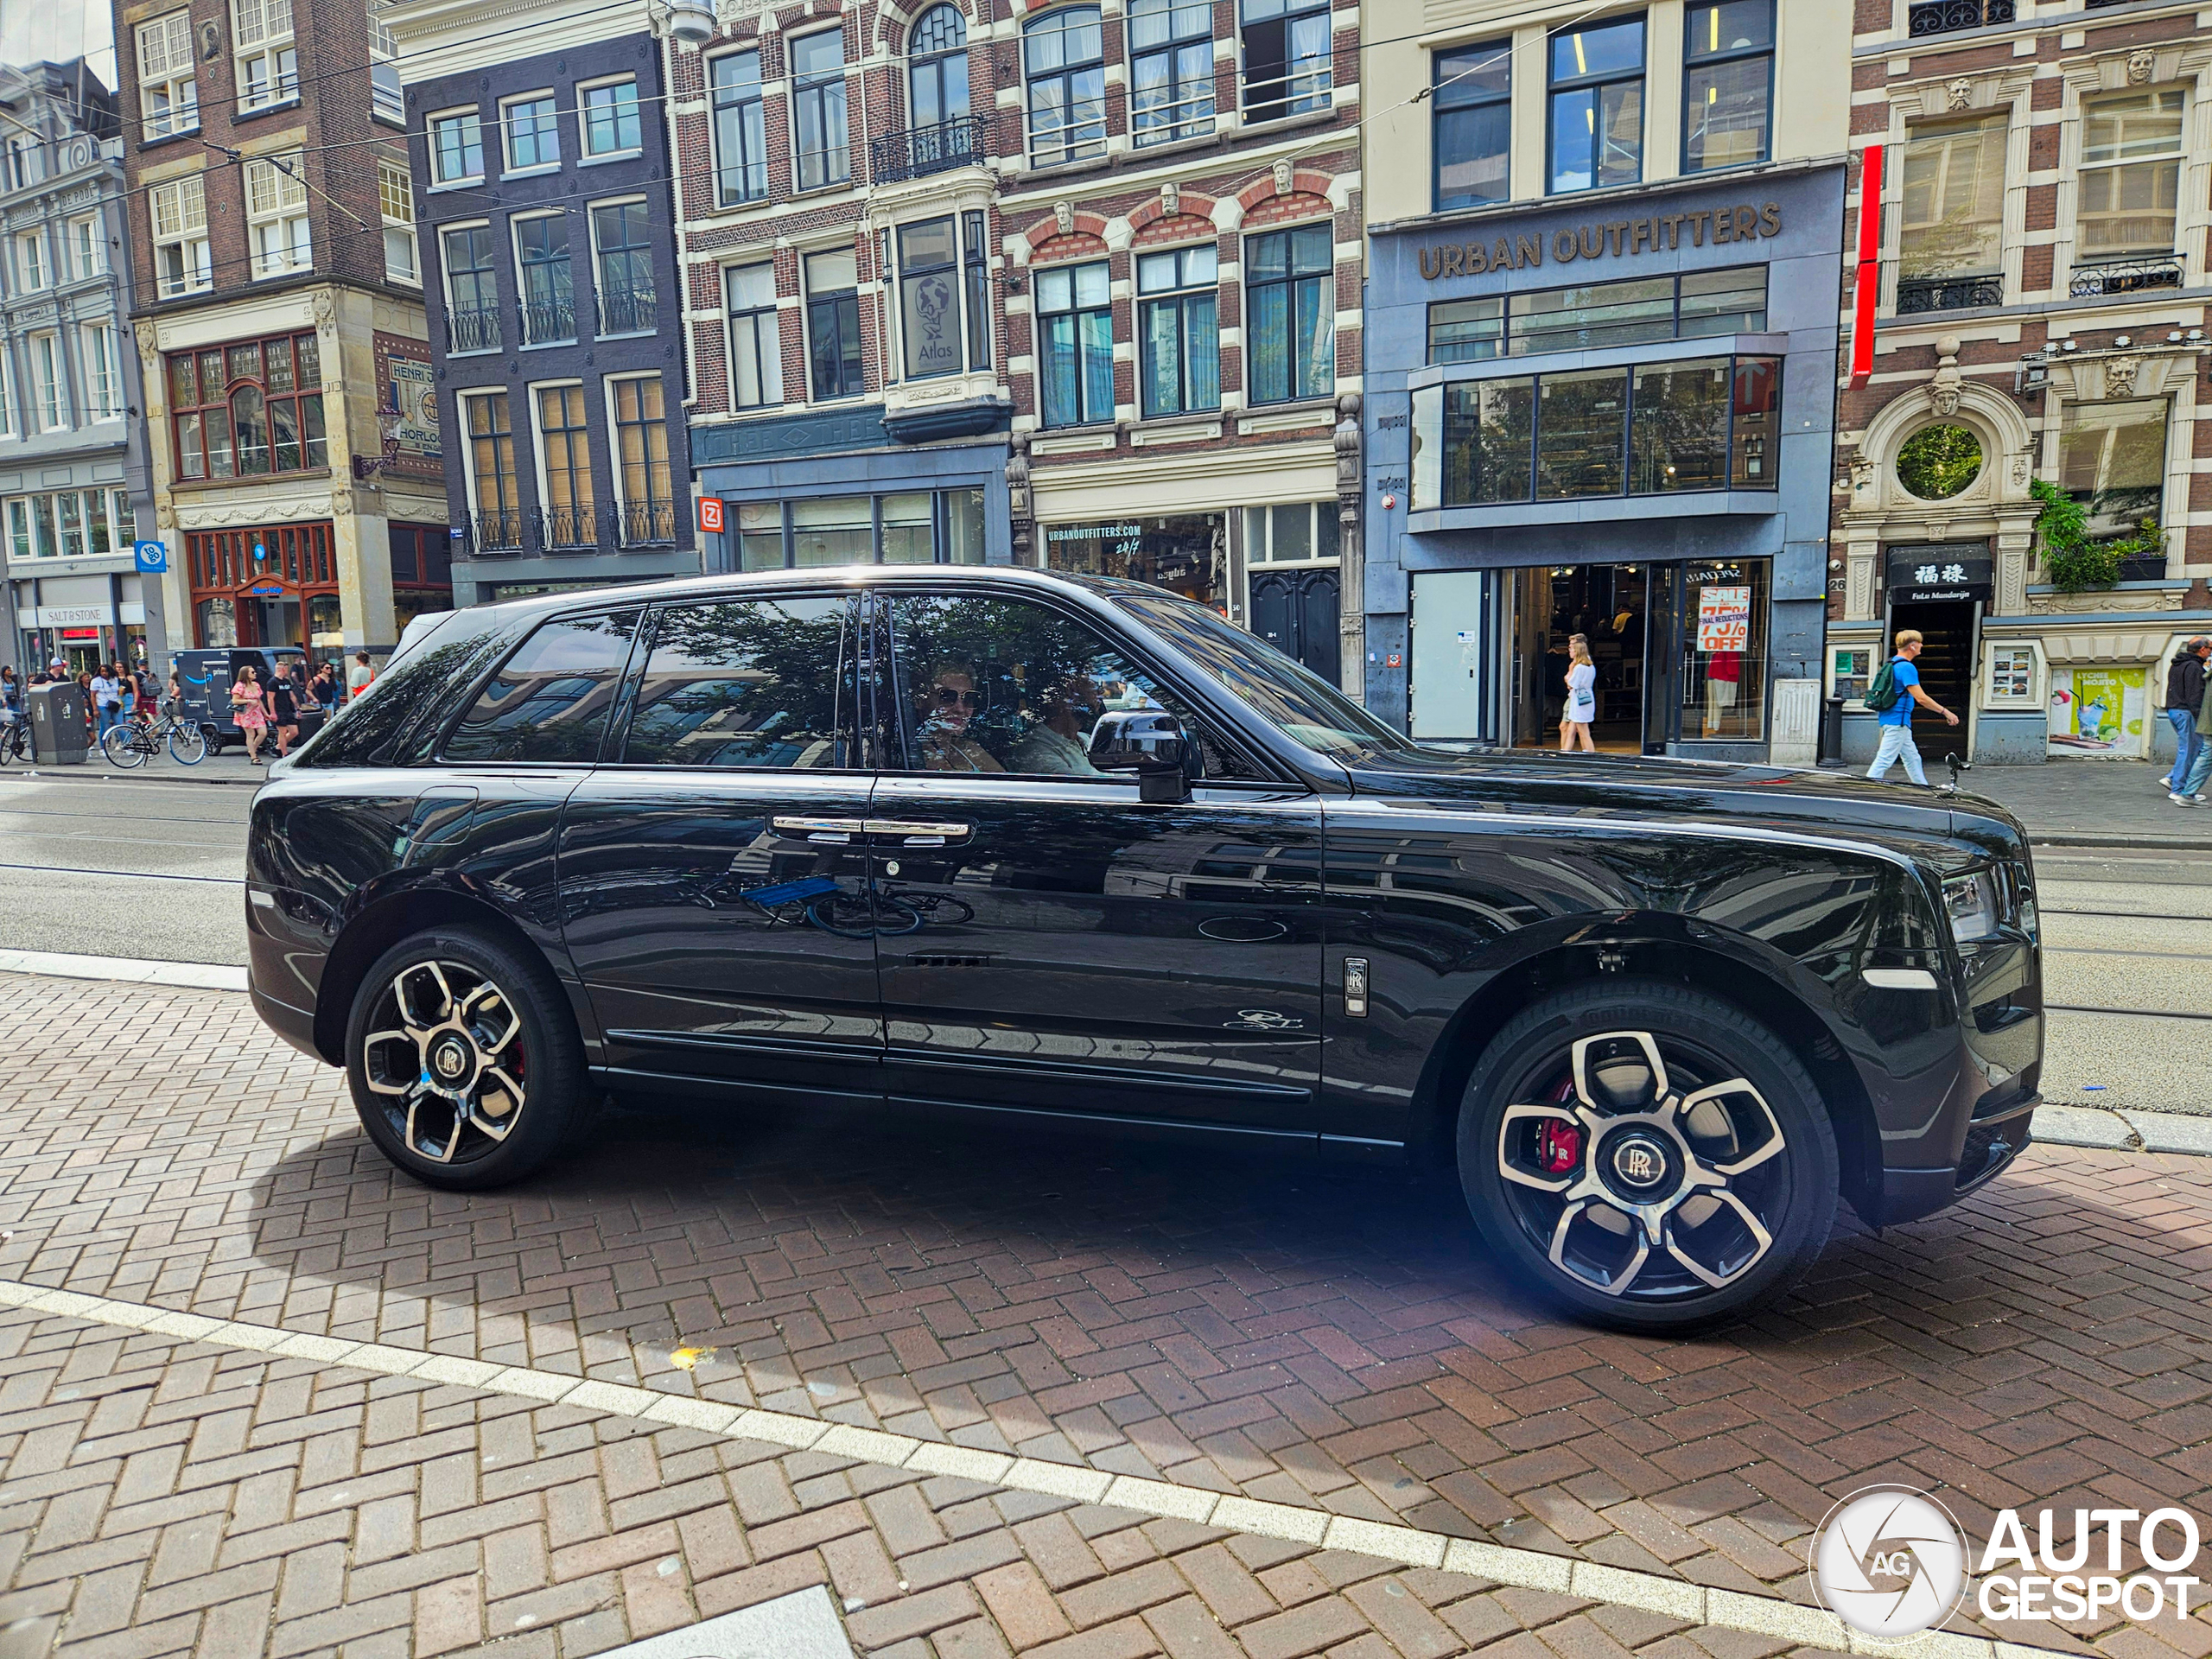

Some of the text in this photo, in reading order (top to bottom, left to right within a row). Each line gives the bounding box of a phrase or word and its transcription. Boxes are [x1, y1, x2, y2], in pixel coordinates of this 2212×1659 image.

[62, 188, 94, 207] DE POOL
[1419, 201, 1781, 280] URBAN OUTFITTERS
[918, 340, 953, 360] Atlas
[394, 365, 424, 381] HENRI
[714, 416, 878, 456] THEE THEE
[1048, 525, 1141, 541] URBANOUTFITTERS.COM
[1116, 537, 1140, 557] 24/7
[149, 552, 160, 563] go
[1829, 579, 1846, 591] 26
[1702, 588, 1748, 602] SALE
[48, 611, 67, 621] SALT
[75, 609, 101, 620] STONE
[1715, 613, 1748, 623] REDUCTIONS
[1704, 637, 1742, 650] OFF
